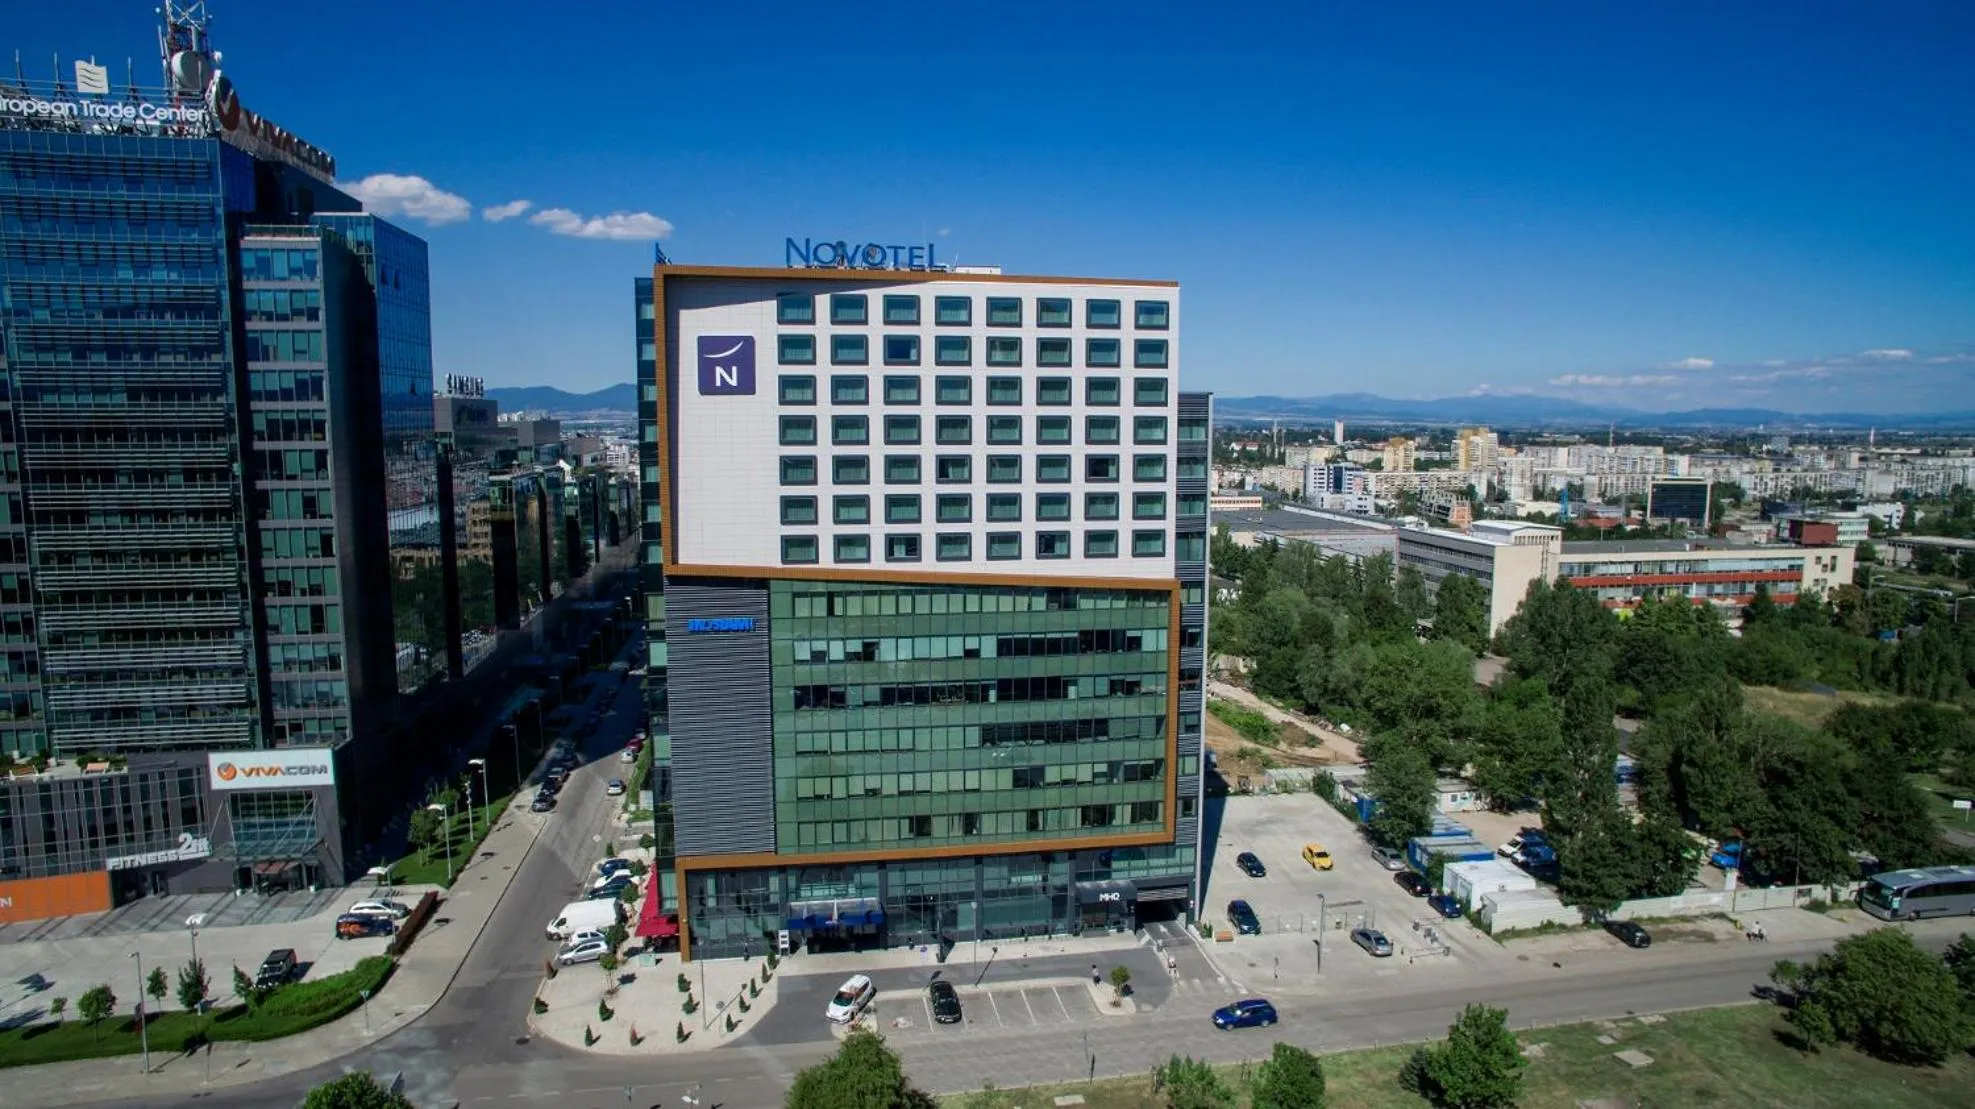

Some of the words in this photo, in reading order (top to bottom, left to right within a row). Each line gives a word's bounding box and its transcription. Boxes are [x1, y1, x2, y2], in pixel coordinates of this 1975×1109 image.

[0, 98, 77, 117] ropean
[80, 100, 136, 118] Trade
[139, 103, 207, 121] Center
[715, 365, 738, 387] N
[240, 764, 328, 778] VIVACOM
[106, 850, 179, 871] FITNESS
